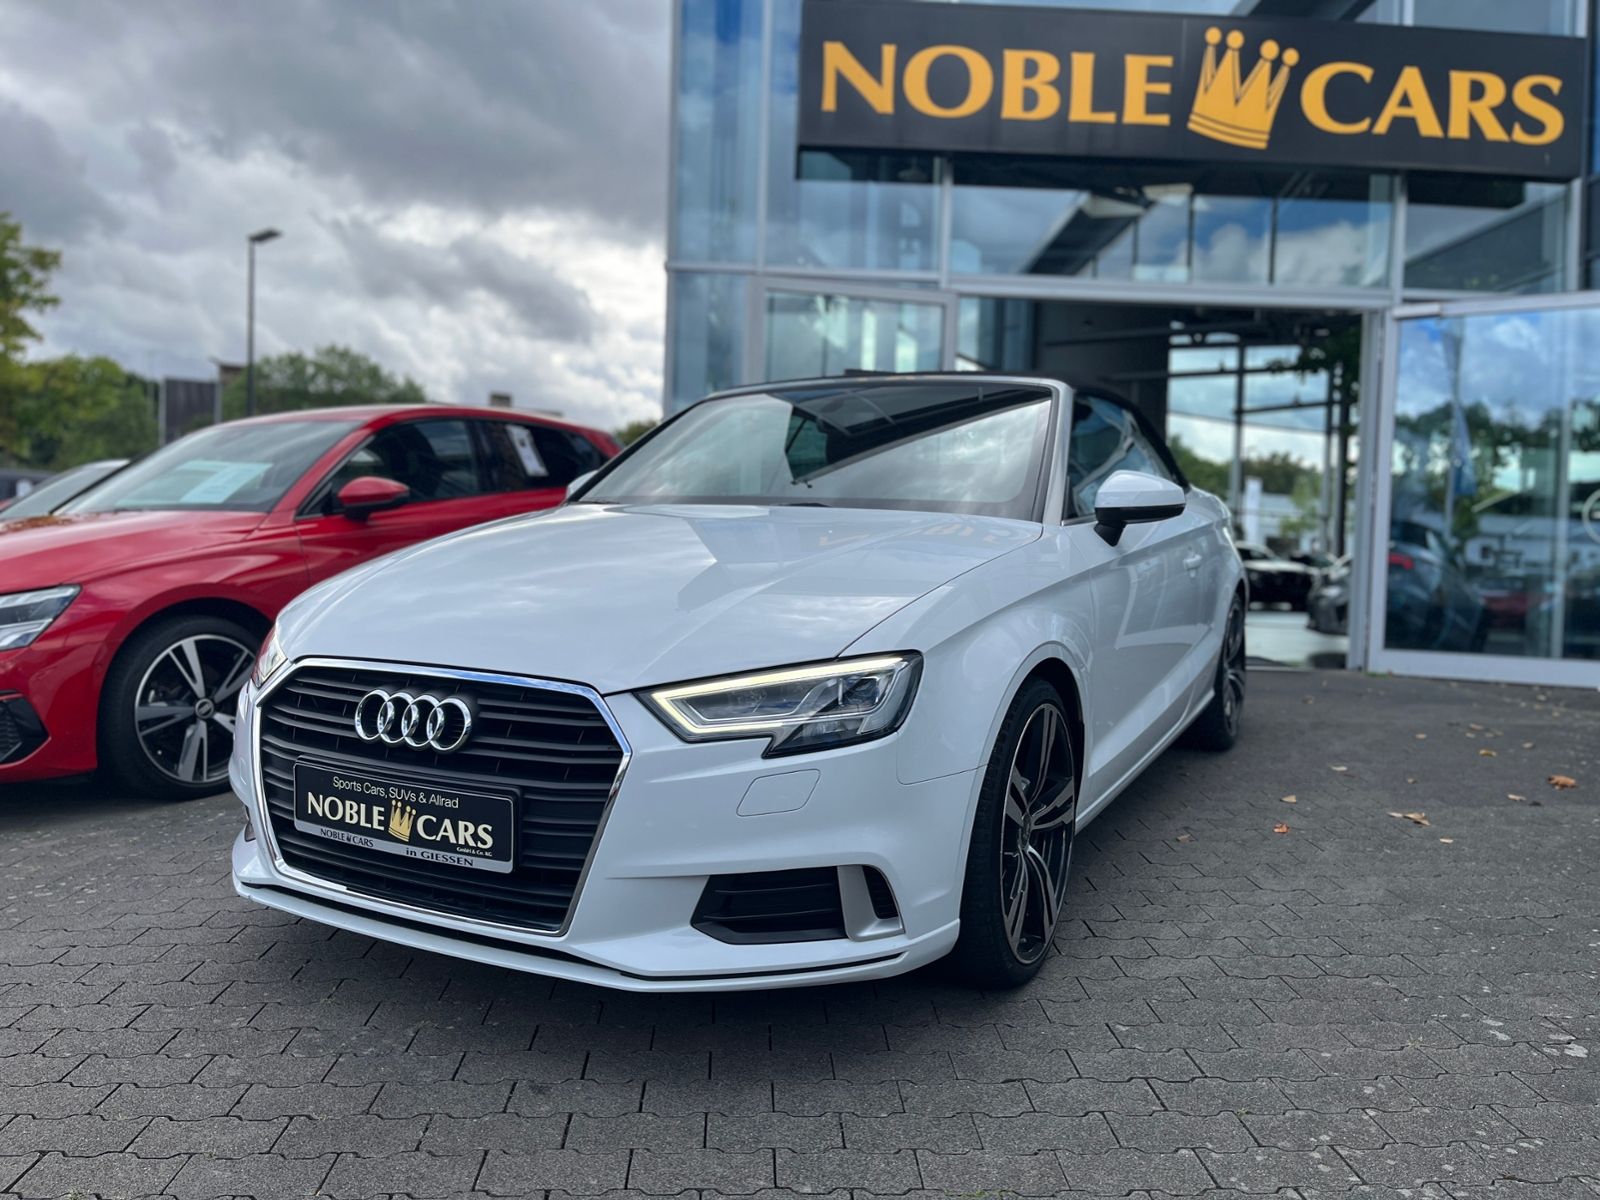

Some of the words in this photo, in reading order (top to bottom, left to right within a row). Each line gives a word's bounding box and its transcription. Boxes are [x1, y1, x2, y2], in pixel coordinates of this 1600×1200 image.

[821, 41, 1174, 126] NOBLE
[1300, 61, 1565, 146] CARS
[333, 776, 362, 792] Sports
[363, 782, 388, 798] Cars,
[389, 786, 416, 802] SUVs
[418, 792, 427, 804] &
[428, 793, 459, 809] Allrad
[307, 791, 385, 831] NOBLE
[416, 814, 494, 849] CARS
[320, 828, 346, 842] NOBLE
[352, 837, 374, 848] CARS
[406, 847, 417, 857] in
[421, 851, 474, 867] GIESSEN
